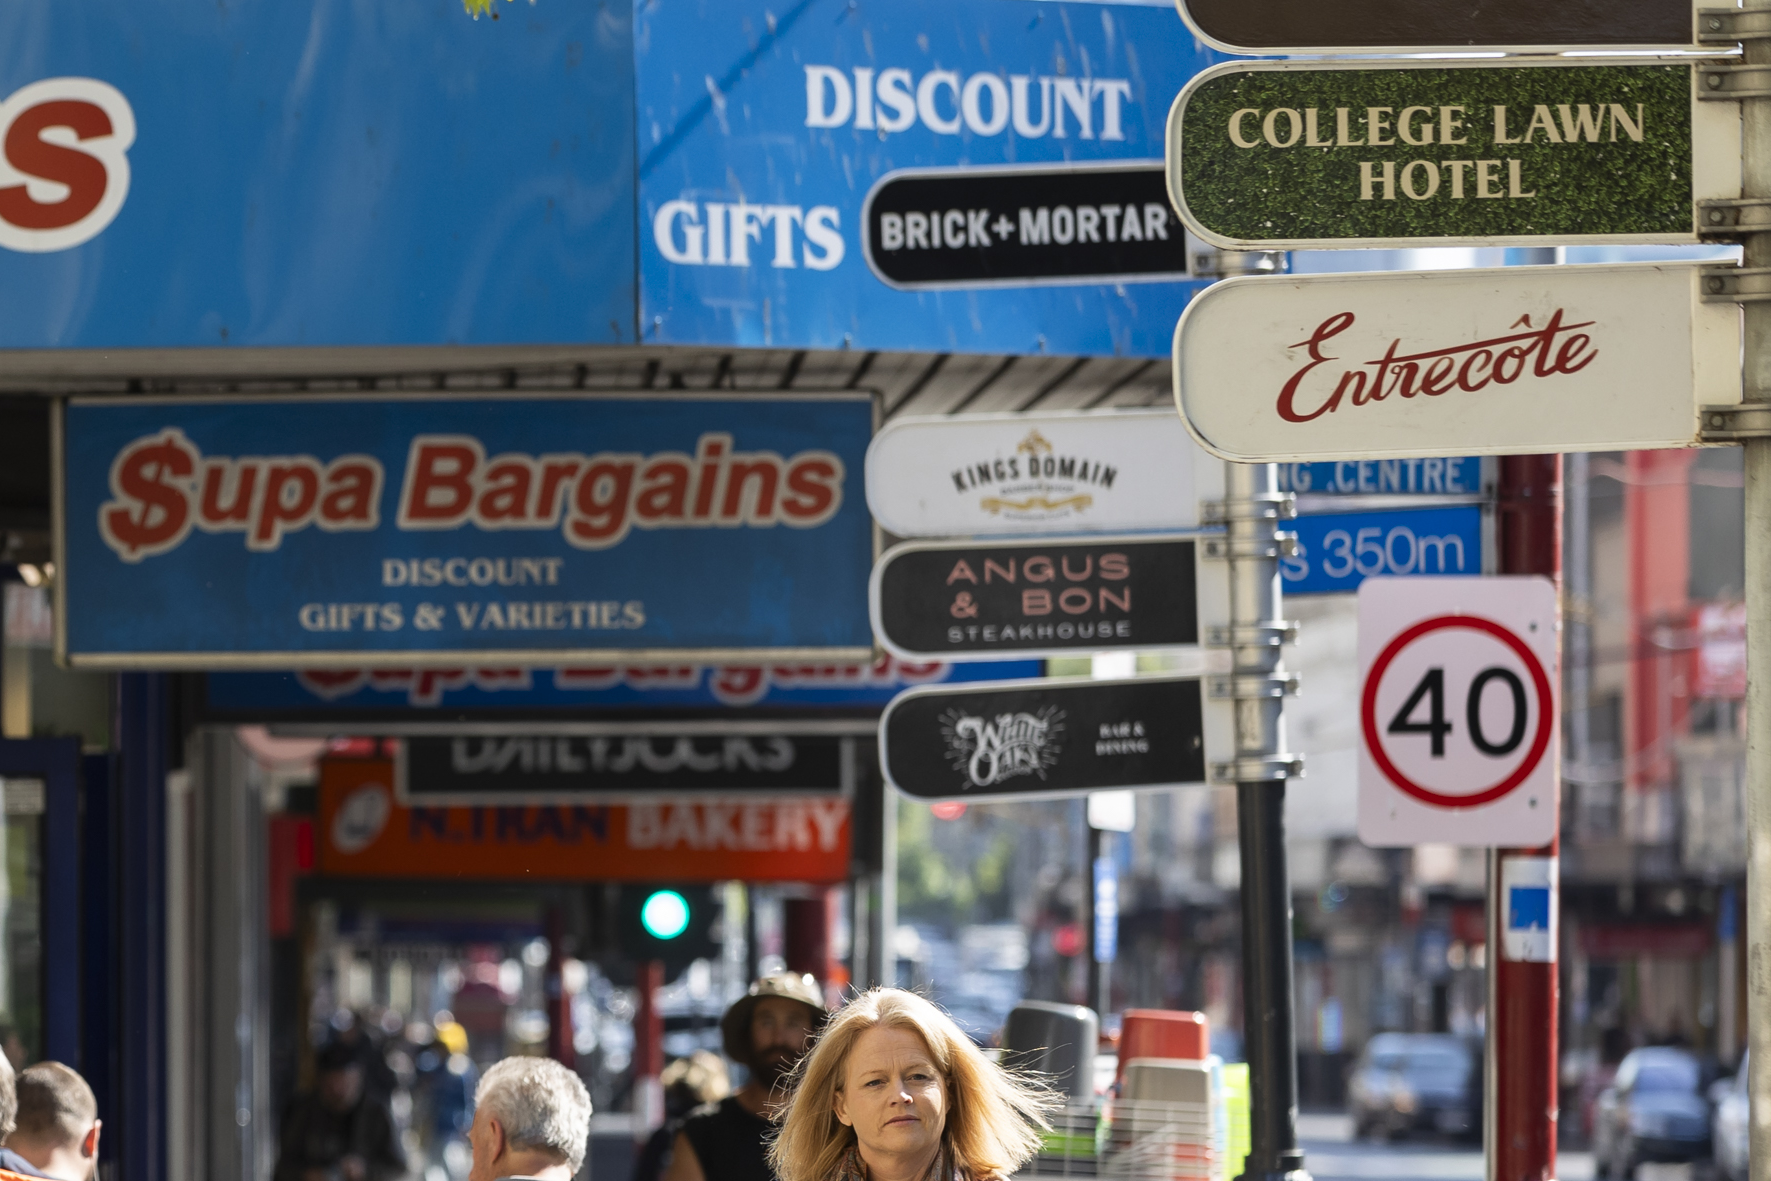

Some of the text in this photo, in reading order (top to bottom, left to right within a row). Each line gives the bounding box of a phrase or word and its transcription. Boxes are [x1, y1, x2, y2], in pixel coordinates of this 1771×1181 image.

[804, 64, 1133, 141] DISCOUNT
[1228, 103, 1645, 149] COLLEGE LAWN
[1359, 159, 1536, 201] HOTEL
[652, 200, 846, 271] GIFTS
[879, 202, 1169, 251] BRICK+MORTAR
[1276, 308, 1599, 423] Entrecôte
[401, 436, 842, 545] Bargains
[950, 455, 1118, 493] KINGS DOMAIN
[381, 557, 564, 587] DISCOUNT
[946, 553, 1131, 586] ANGUS
[1323, 526, 1465, 578] 350m
[298, 600, 646, 632] GIFTS & VARIETIES
[950, 586, 1131, 619] & BON
[947, 620, 1132, 643] STEAKHOUSE
[1388, 667, 1528, 759] 40
[1095, 738, 1150, 756] DINING
[626, 801, 850, 852] BAKERY
